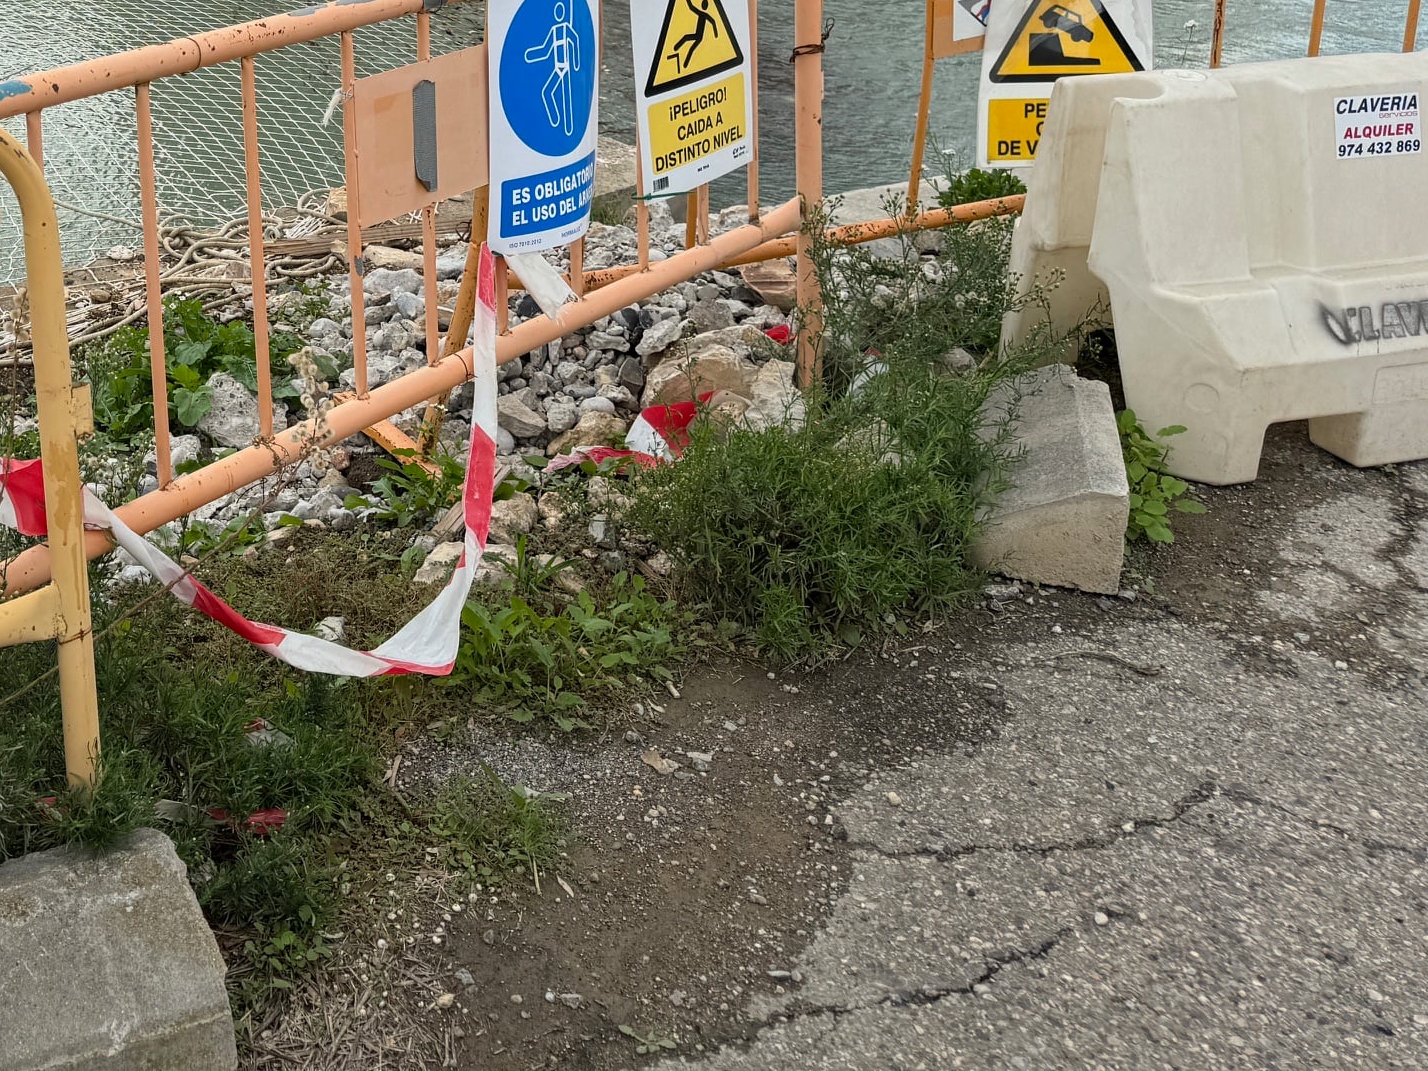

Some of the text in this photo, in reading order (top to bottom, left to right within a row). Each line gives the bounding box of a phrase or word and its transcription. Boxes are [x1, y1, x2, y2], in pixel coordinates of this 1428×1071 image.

[669, 87, 727, 121] ¡PELIGRO!
[1336, 94, 1418, 115] CLAVERIA
[677, 111, 724, 141] CAIDA A
[1343, 123, 1414, 139] ALQUILER
[655, 125, 743, 172] DISTINTO NIVEL
[997, 140, 1021, 156] DE
[1338, 139, 1421, 157] 974 432 869
[512, 186, 531, 205] ES
[512, 210, 529, 226] EL
[532, 203, 557, 222] USO
[559, 196, 577, 216] DEL
